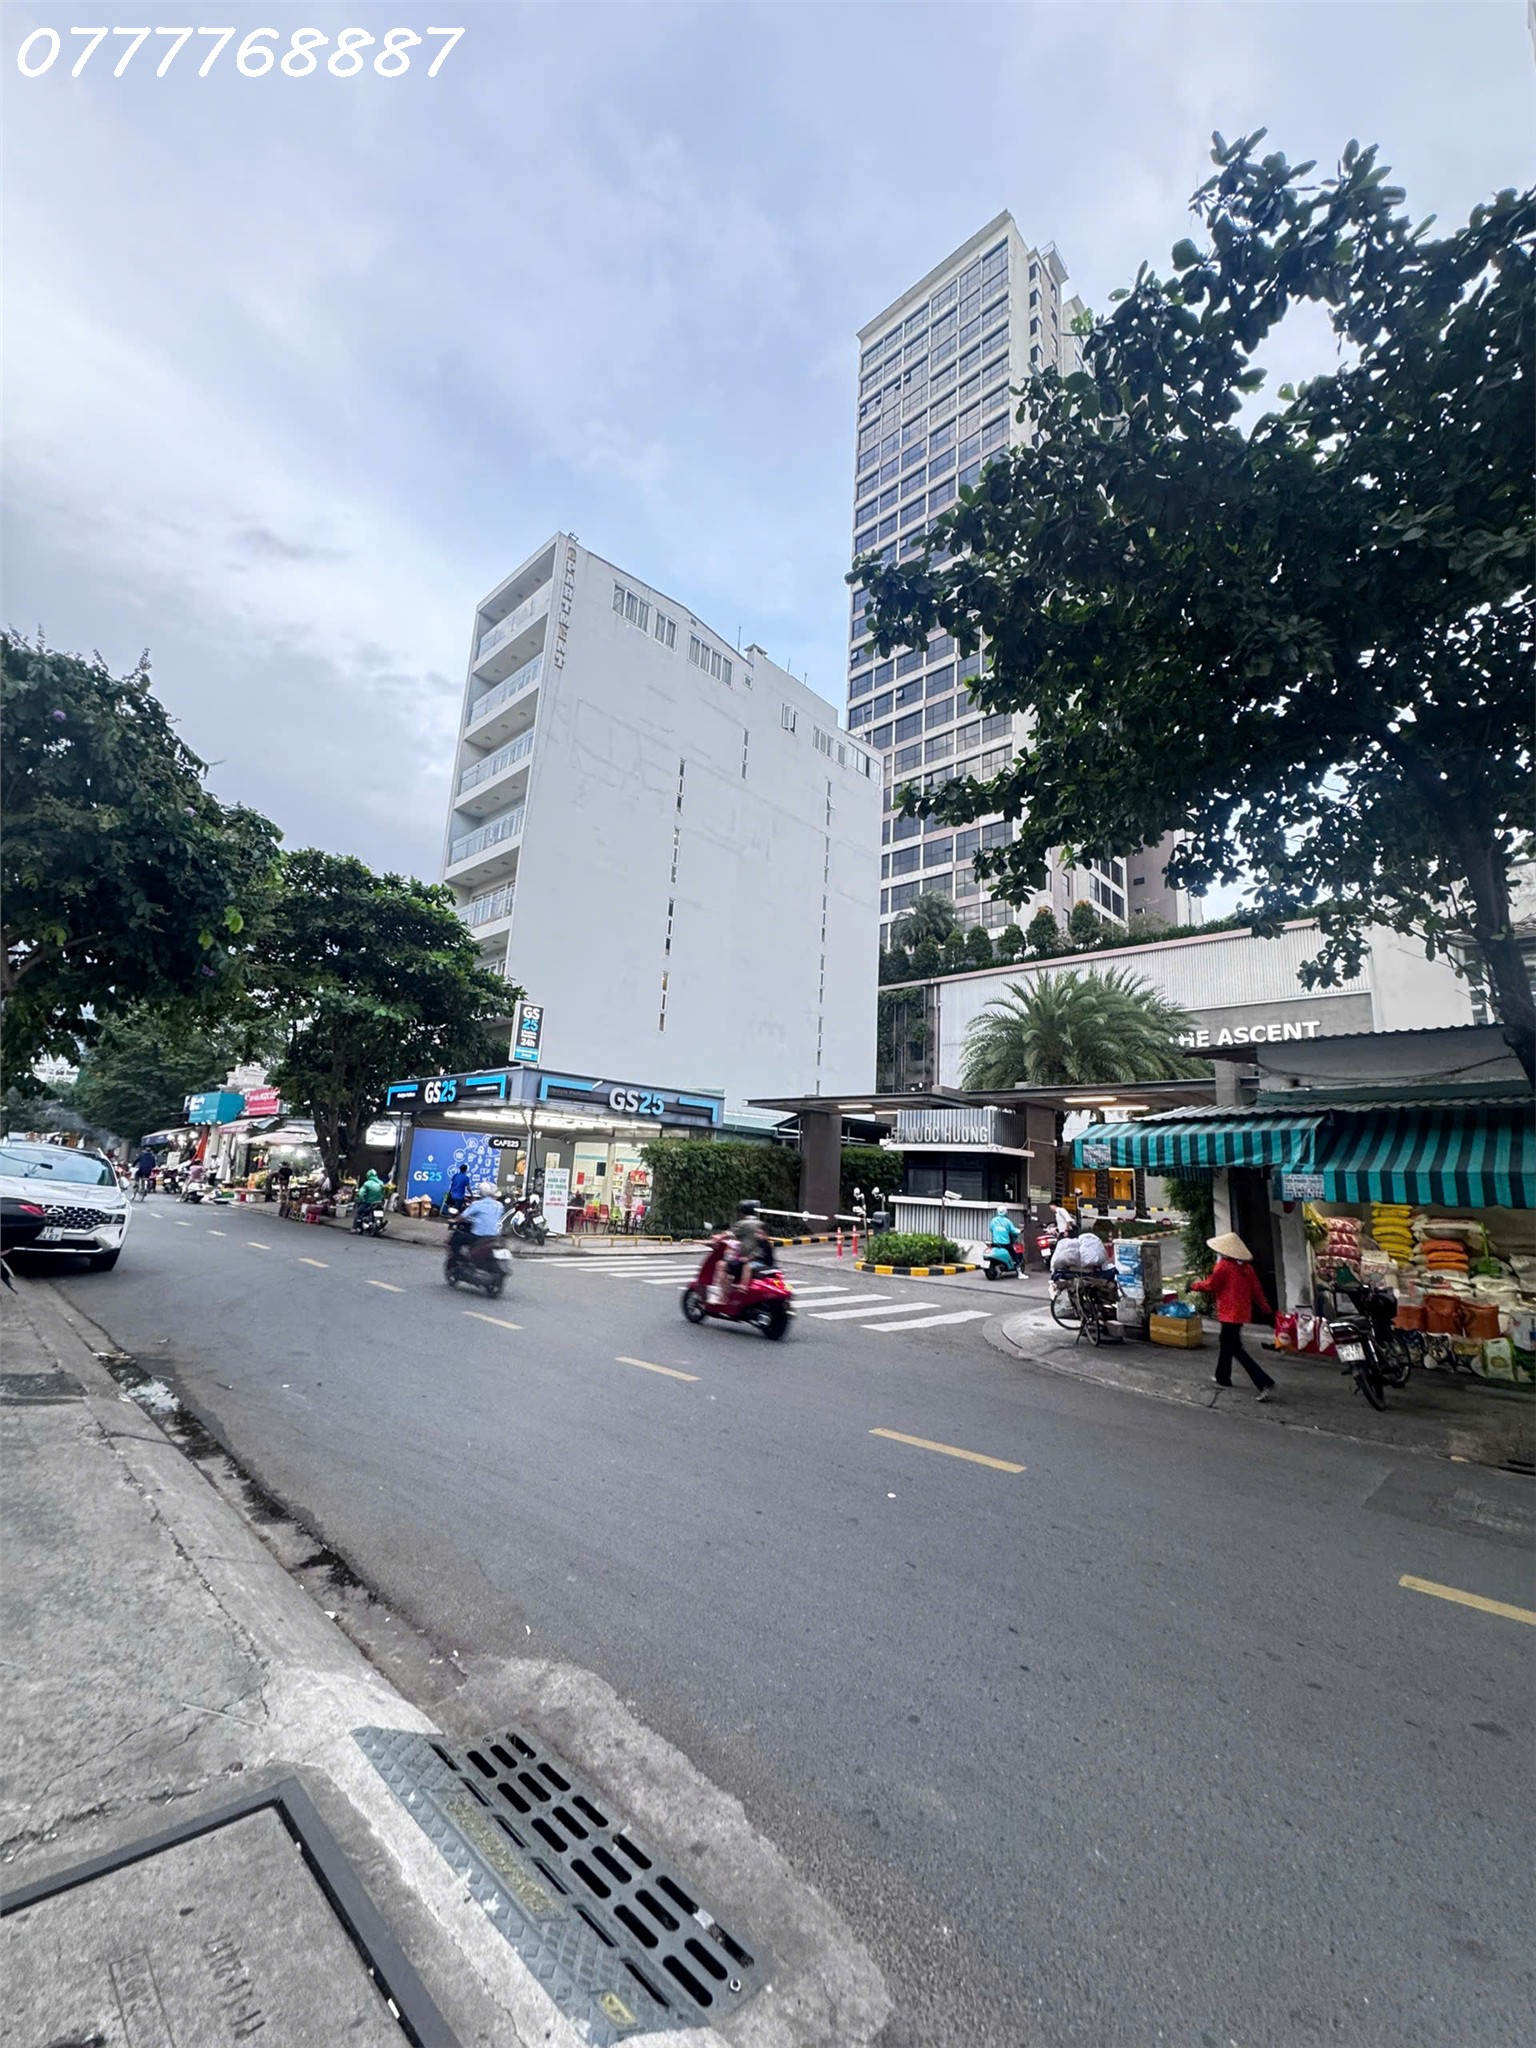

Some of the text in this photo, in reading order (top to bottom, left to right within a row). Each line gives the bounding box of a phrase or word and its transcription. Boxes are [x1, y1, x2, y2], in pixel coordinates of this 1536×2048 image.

[523, 1006, 541, 1020] GS
[521, 1018, 539, 1031] 25
[1169, 1020, 1321, 1048] HE ASCENT
[424, 1080, 457, 1104] GS25
[609, 1087, 665, 1115] GS25
[413, 1170, 442, 1181] GS25
